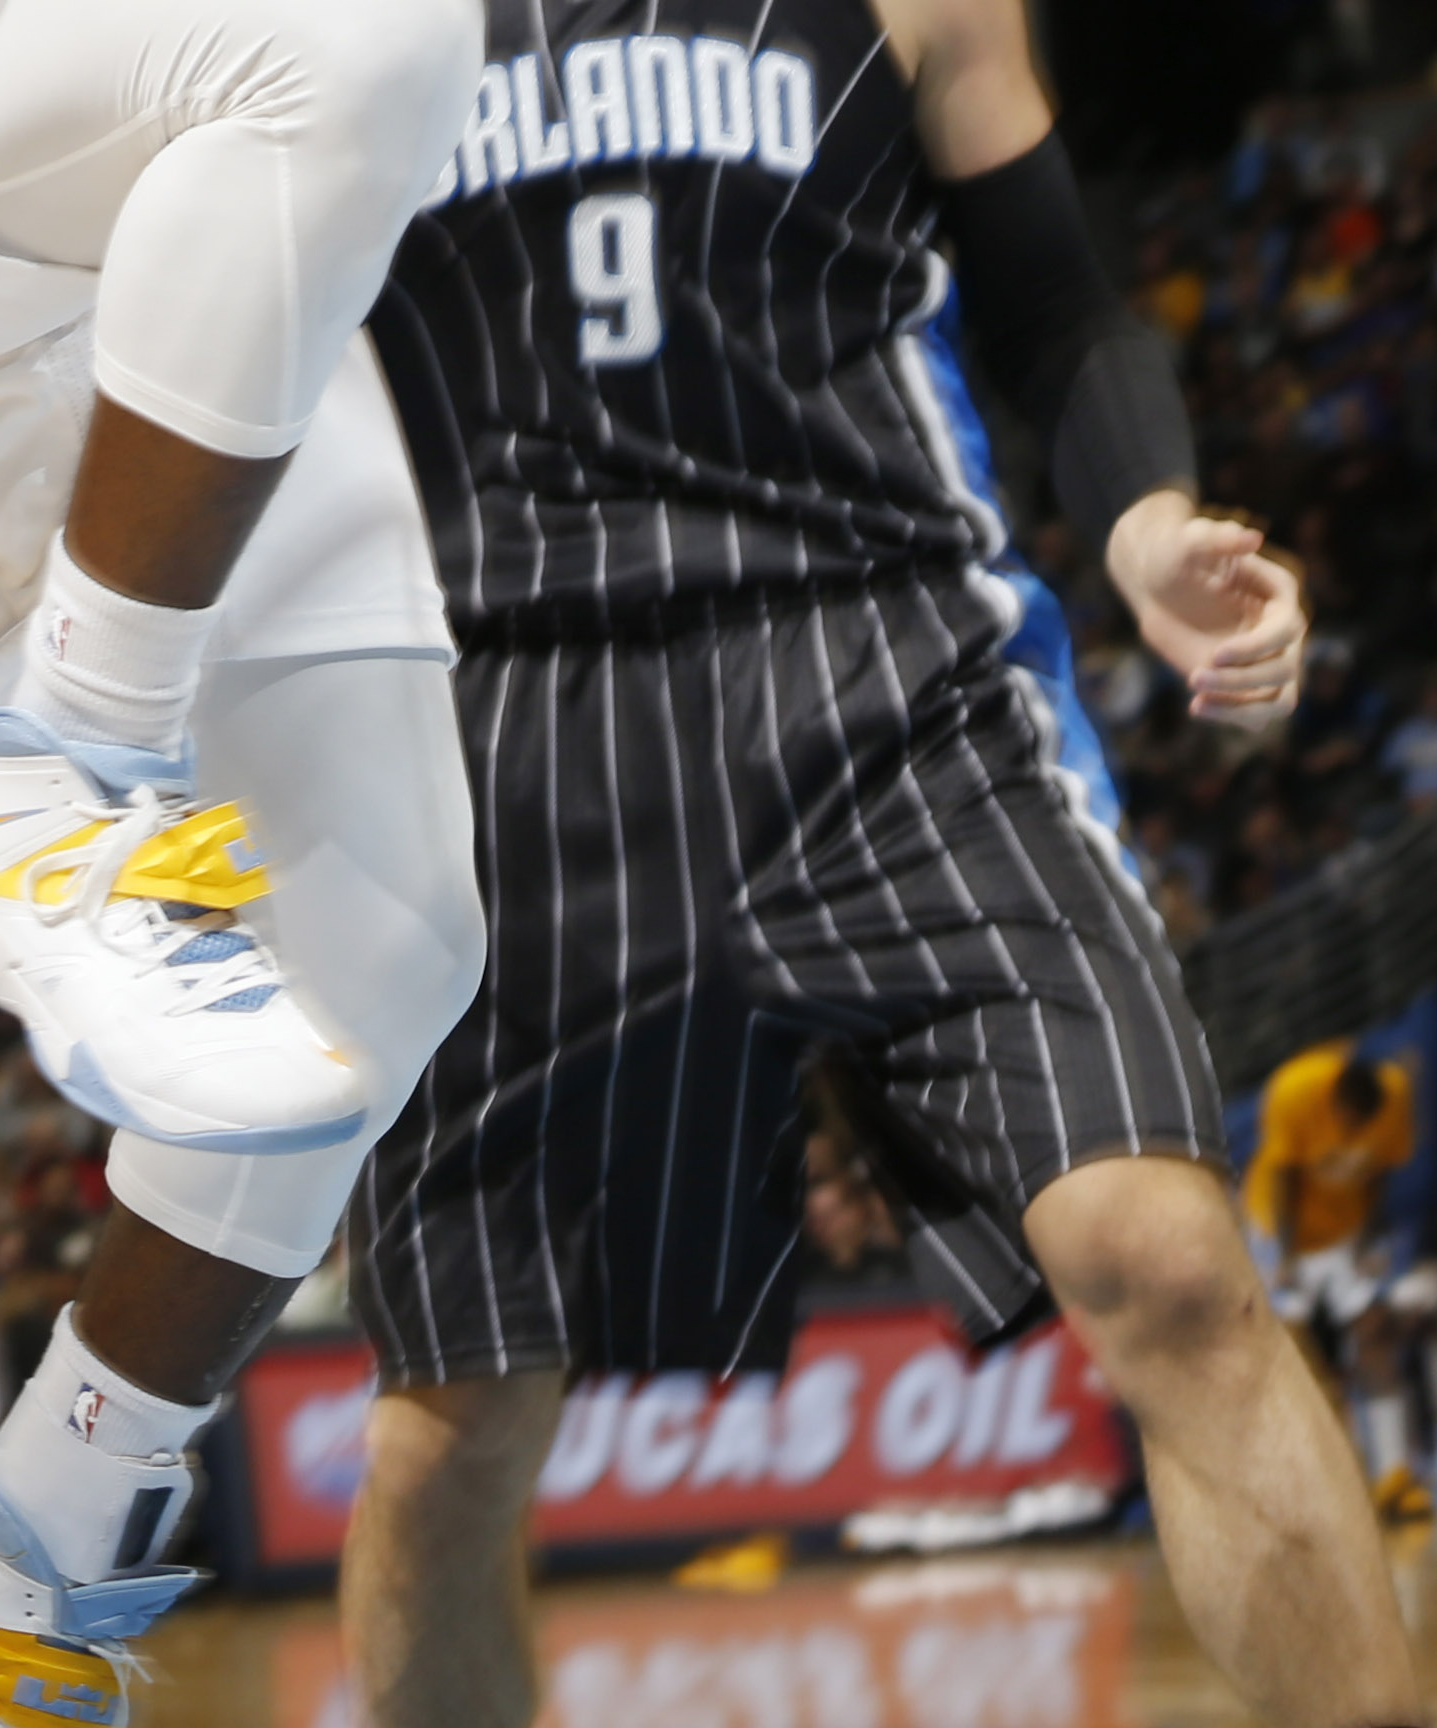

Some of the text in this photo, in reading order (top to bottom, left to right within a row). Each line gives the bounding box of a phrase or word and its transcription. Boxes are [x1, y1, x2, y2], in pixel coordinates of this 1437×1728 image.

[420, 34, 817, 213] RLANDO
[569, 192, 665, 365] 9
[535, 1338, 1075, 1502] UCAS OIL
